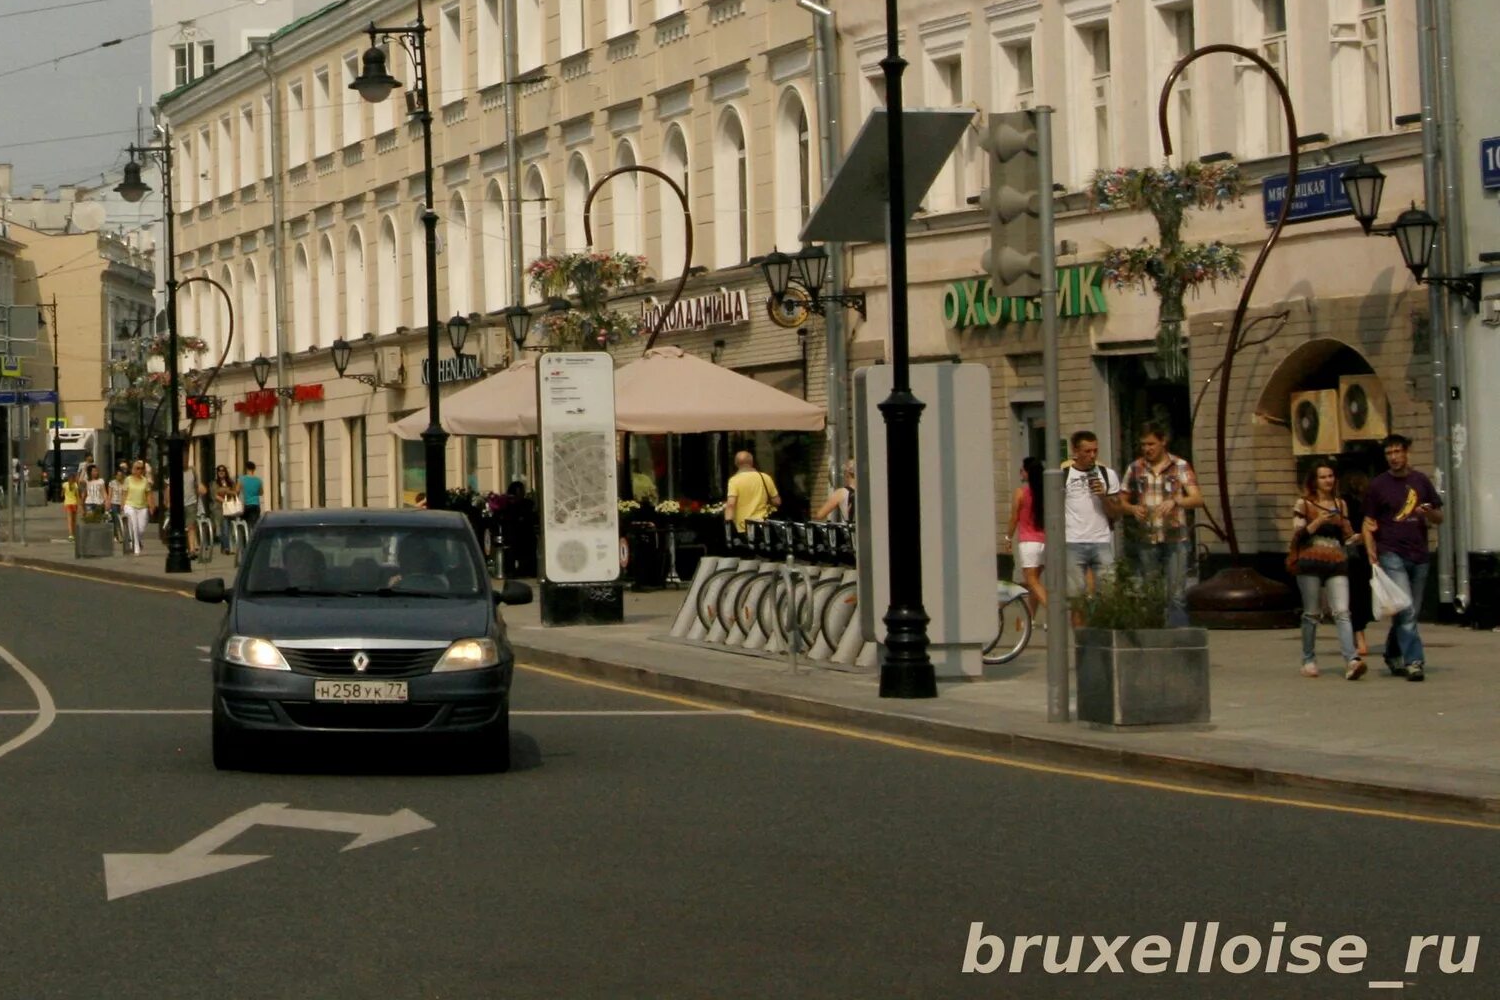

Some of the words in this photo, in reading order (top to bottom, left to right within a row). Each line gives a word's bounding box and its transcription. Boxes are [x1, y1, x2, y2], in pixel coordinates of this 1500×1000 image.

[1268, 179, 1326, 201] МЯСИЦКАЯ
[421, 357, 482, 384] KHENLAND
[388, 683, 402, 695] 77
